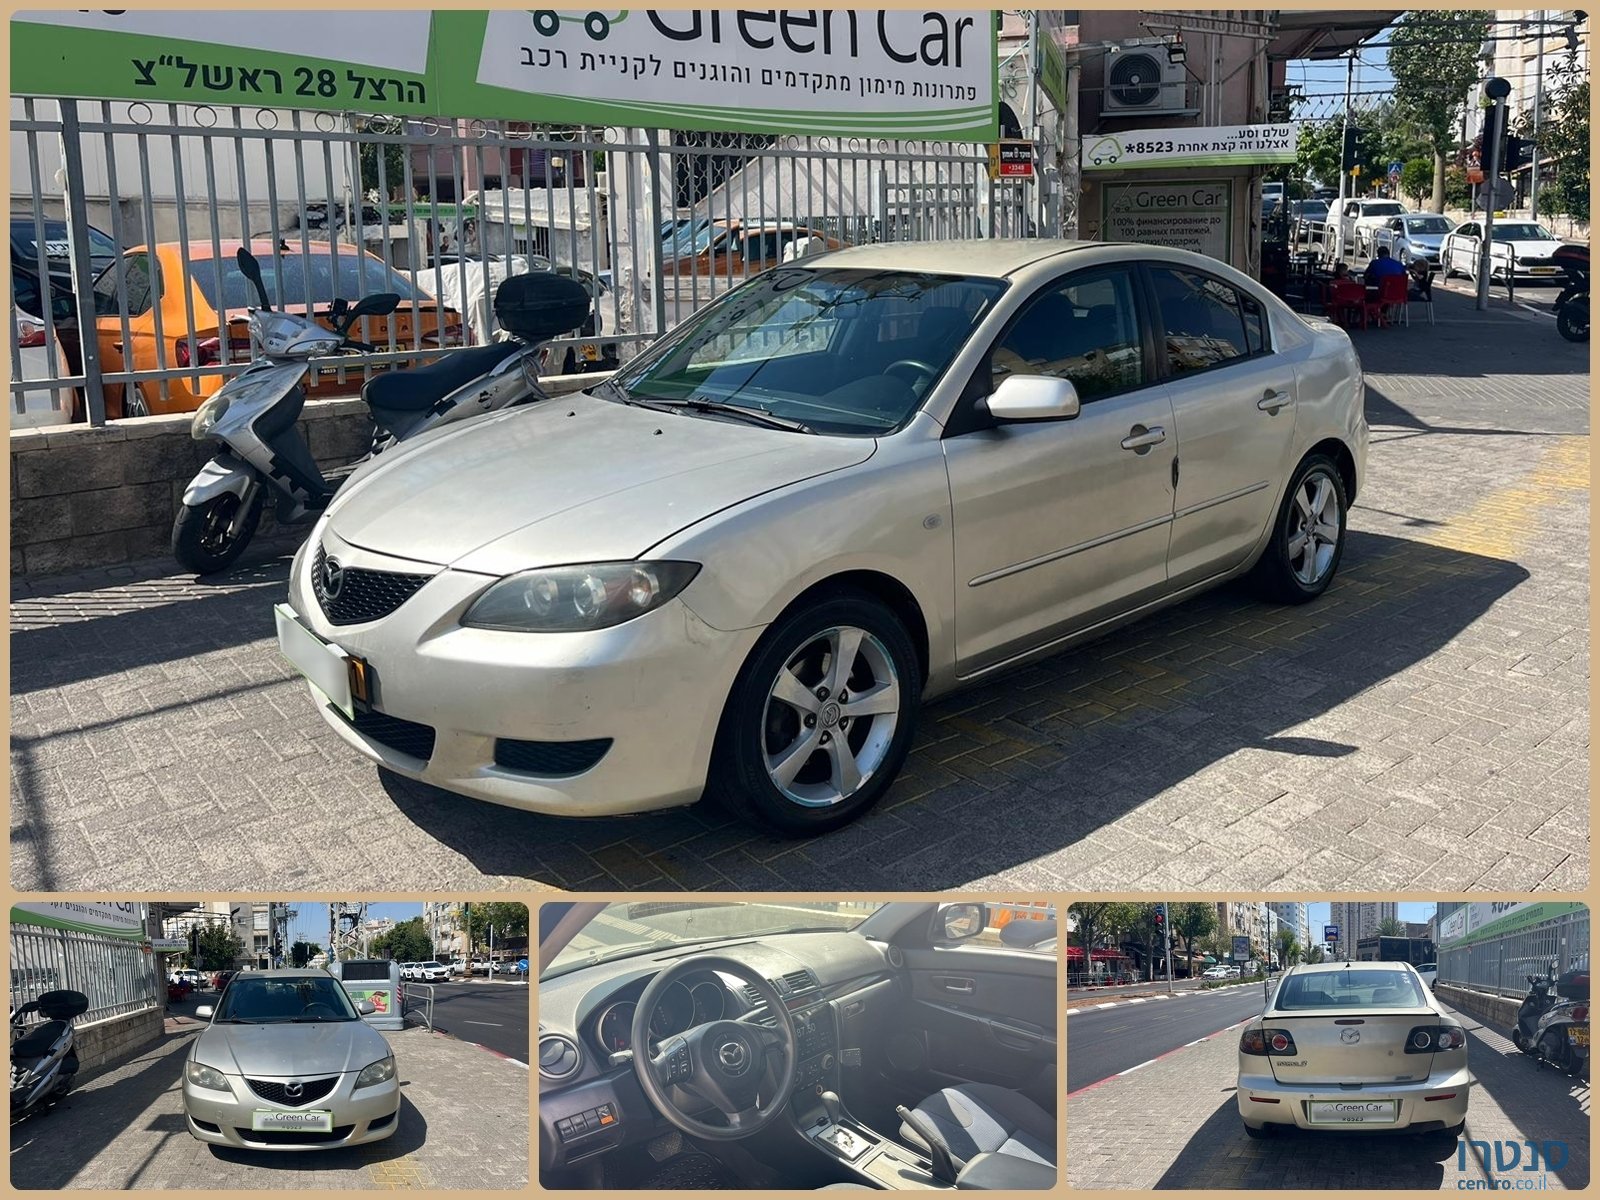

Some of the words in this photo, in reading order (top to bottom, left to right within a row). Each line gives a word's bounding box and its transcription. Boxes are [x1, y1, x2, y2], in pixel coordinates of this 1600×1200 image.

[877, 10, 974, 68] Car
[520, 46, 568, 68] רכב
[580, 51, 662, 80] לקניית
[673, 60, 751, 84] והוגנים
[294, 66, 338, 97] 28
[346, 70, 426, 104] הרצל
[761, 69, 851, 93] מתקדמים
[859, 77, 905, 97] מימון
[911, 80, 976, 101] פתרונות
[1262, 127, 1289, 137] שלם
[1177, 143, 1208, 153] אחרת
[1211, 141, 1236, 153] קצת
[1240, 141, 1252, 150] זה
[1256, 139, 1289, 150] אצלנו
[1136, 191, 1188, 207] Green
[1192, 190, 1222, 206] Car
[1112, 218, 1134, 226] 100%
[1136, 216, 1209, 227] финансирование
[1209, 216, 1221, 226] до
[1121, 228, 1135, 236] 100
[1137, 228, 1169, 238] равных
[1335, 1103, 1364, 1112] Green
[1366, 1103, 1383, 1112] Car
[275, 1113, 303, 1121] Green
